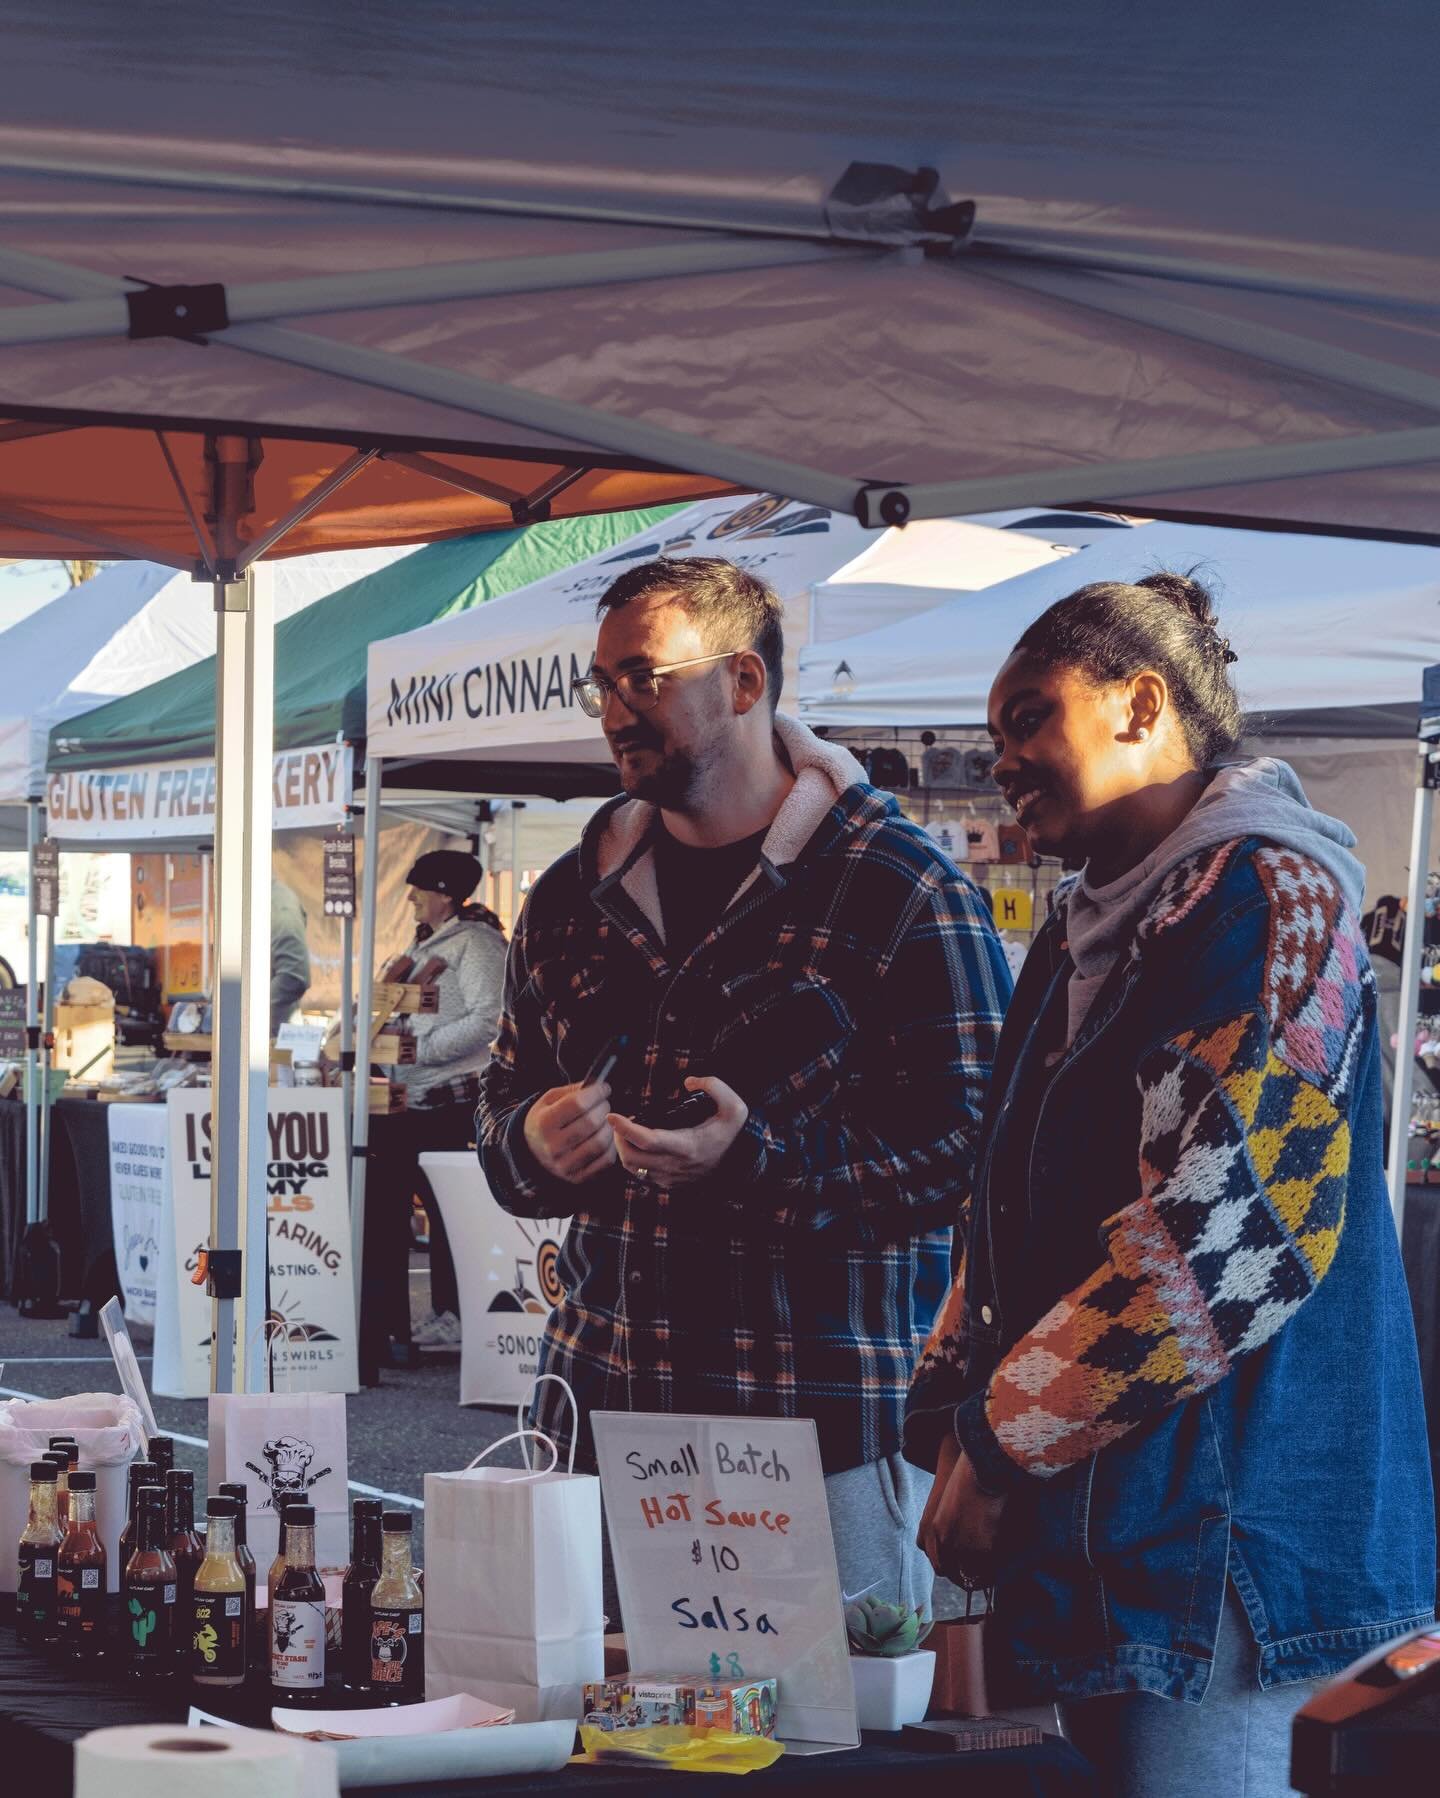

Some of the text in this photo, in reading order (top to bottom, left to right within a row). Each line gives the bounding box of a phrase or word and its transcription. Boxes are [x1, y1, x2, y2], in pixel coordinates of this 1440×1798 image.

[387, 671, 458, 727] MINI
[50, 771, 149, 821] GLUTEN
[271, 750, 341, 808] KERY
[1003, 898, 1017, 921] H
[267, 1111, 330, 1161] YOU
[267, 1216, 343, 1277] TARING.
[268, 1263, 321, 1277] ASTING.
[282, 1350, 335, 1362] SWIRLS
[626, 1442, 790, 1482] Small Batch
[705, 1500, 791, 1534] Sauce
[691, 1539, 740, 1573] $10
[671, 1596, 779, 1636] Salsa
[708, 1651, 745, 1677] $8
